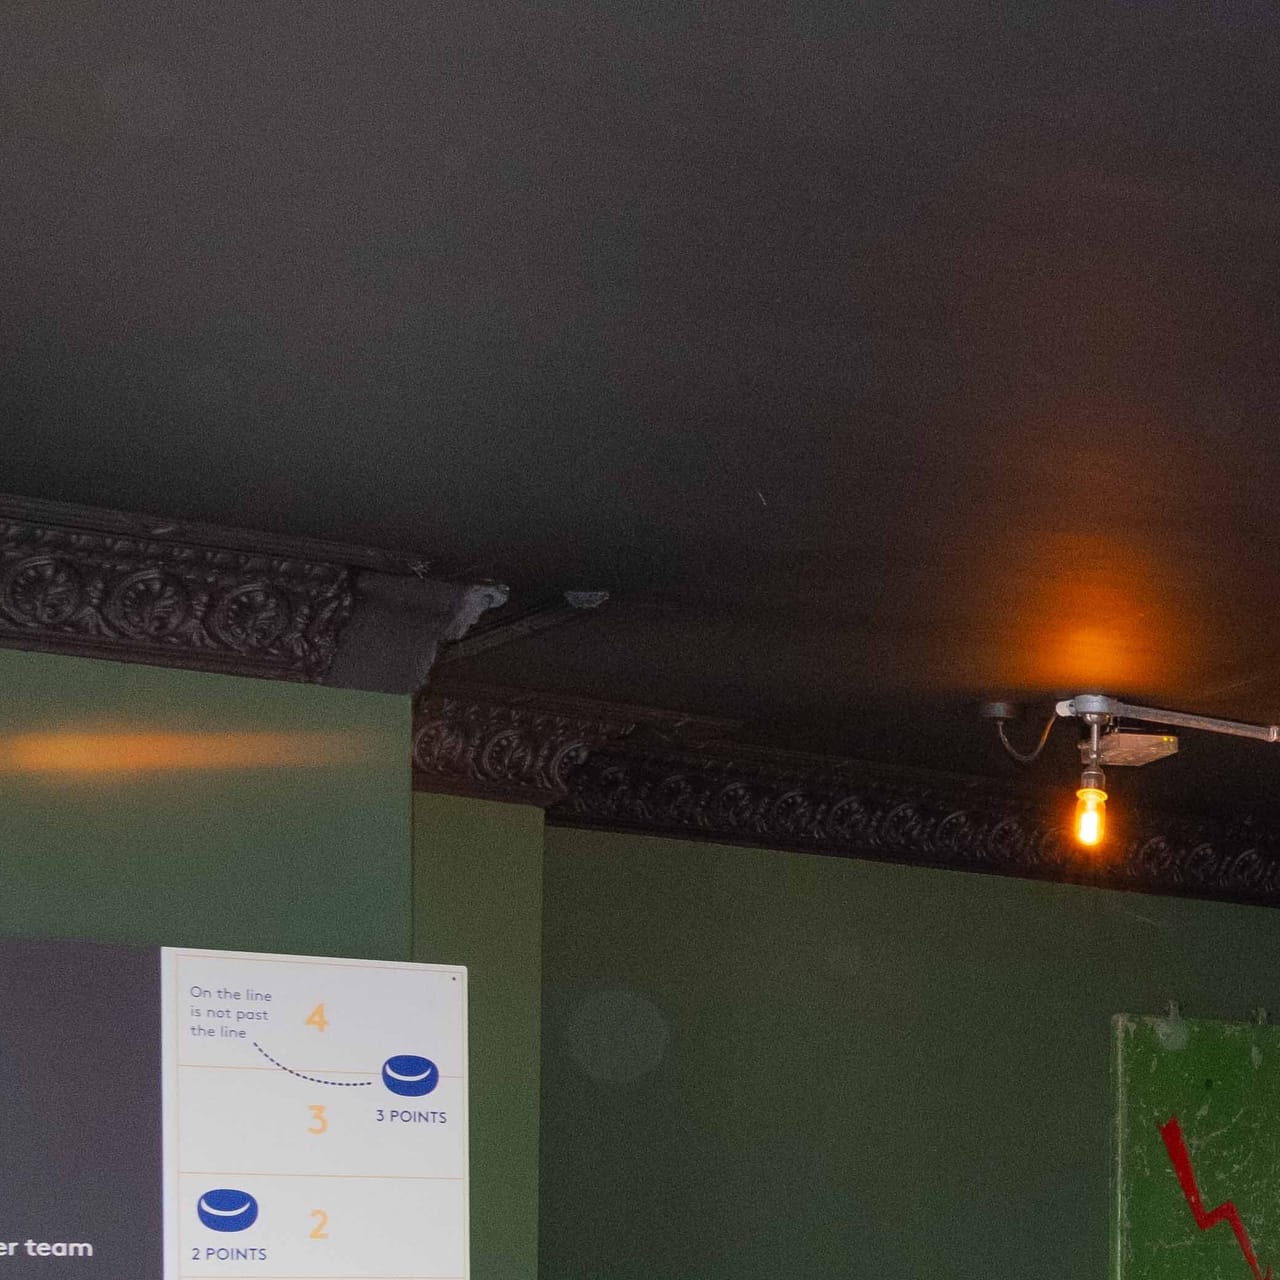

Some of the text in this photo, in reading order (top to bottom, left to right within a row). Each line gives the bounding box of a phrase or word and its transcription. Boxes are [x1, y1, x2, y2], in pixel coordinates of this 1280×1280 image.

[190, 985, 272, 1002] On the line
[190, 1004, 269, 1022] is not past
[305, 1003, 330, 1032] 4
[190, 1025, 246, 1039] the line
[307, 1105, 328, 1135] 3
[376, 1109, 447, 1124] 3 POINTS
[309, 1208, 329, 1239] 2
[24, 1239, 94, 1257] team
[191, 1248, 267, 1262] 2 POINTS
